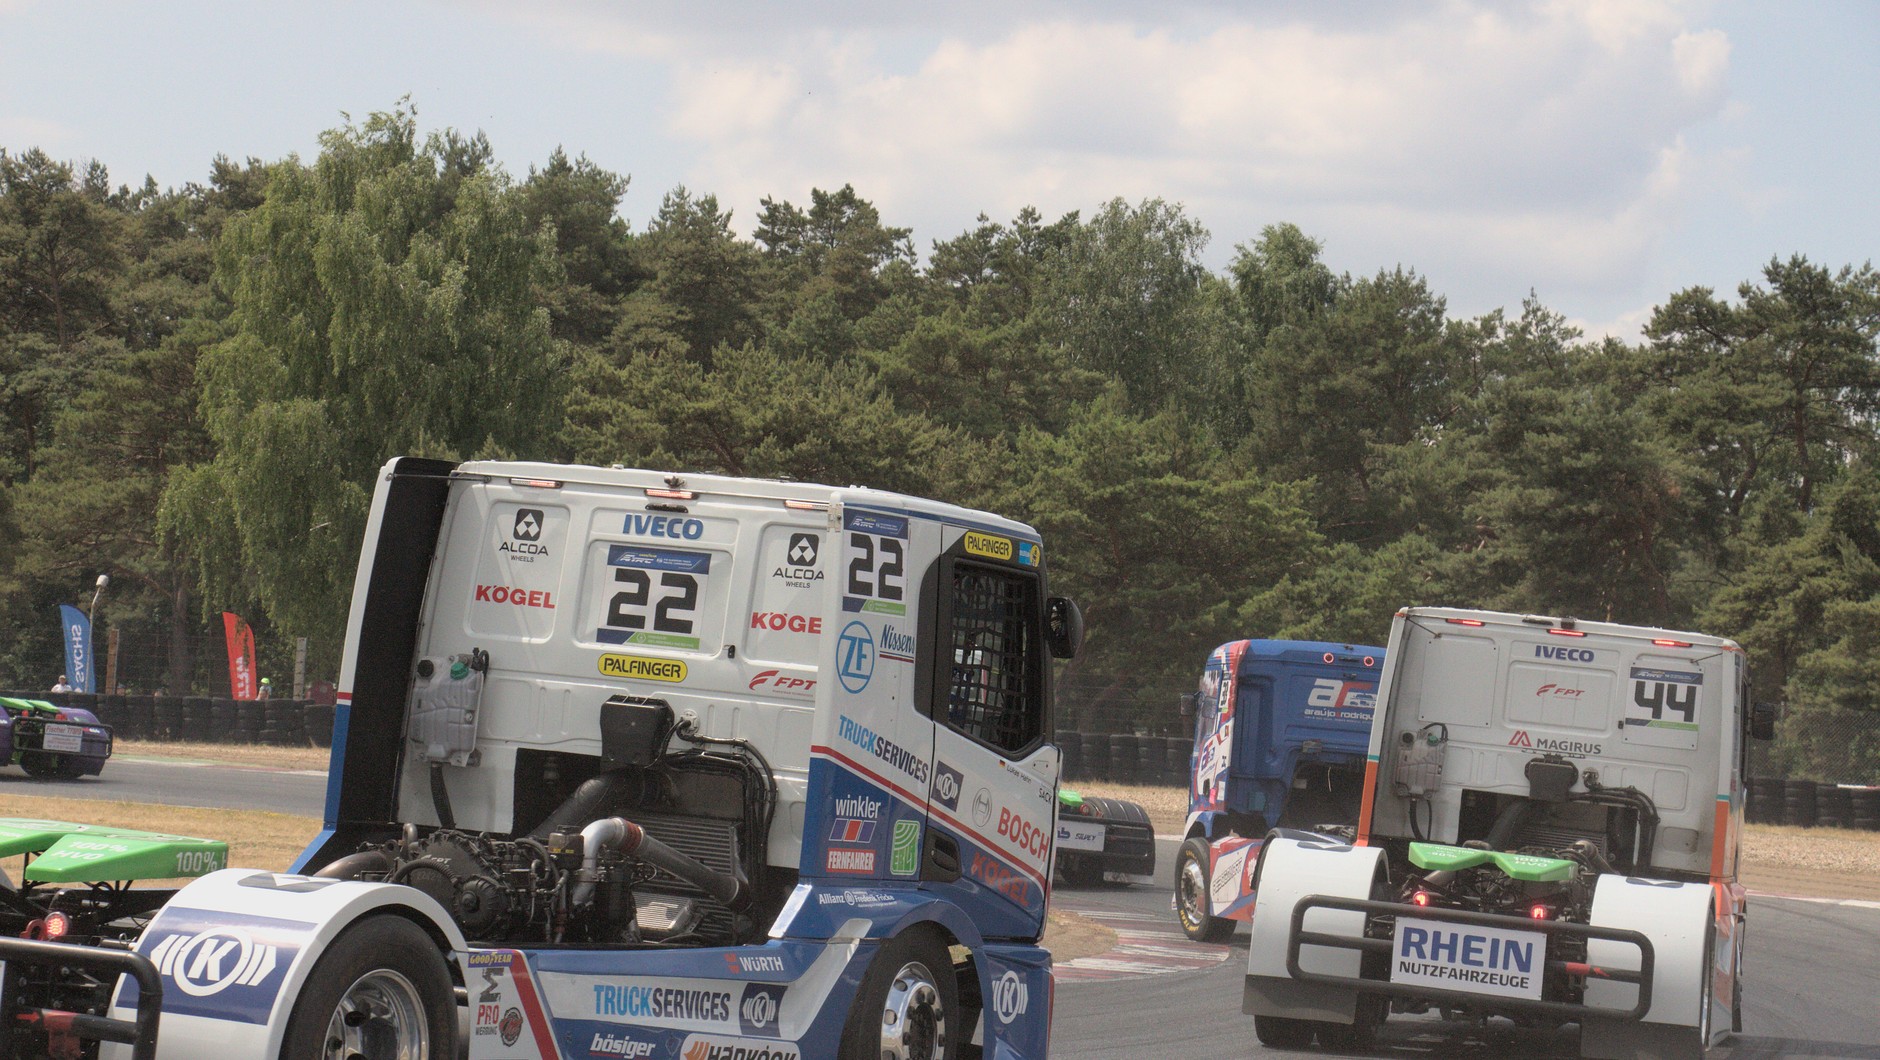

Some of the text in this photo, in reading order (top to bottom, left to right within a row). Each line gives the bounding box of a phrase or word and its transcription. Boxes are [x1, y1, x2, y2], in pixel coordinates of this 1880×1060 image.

[622, 513, 704, 540] IVECO
[499, 541, 549, 556] ALCOA
[967, 535, 1010, 556] PALFINGER
[510, 555, 534, 563] WHEELS
[848, 533, 903, 601] 22
[772, 567, 824, 581] ALCOA
[475, 584, 555, 609] KÖGEL
[607, 568, 698, 634] 22
[880, 623, 915, 654] Nissens
[840, 634, 873, 680] ZF
[1535, 645, 1595, 662] IVECO
[603, 657, 682, 678] PALFINGER
[773, 676, 817, 690] FPT
[1554, 688, 1585, 697] FPT
[1634, 680, 1697, 723] 44
[1536, 738, 1602, 755] MAGIRUS
[835, 794, 882, 819] winkler
[997, 806, 1050, 862] BOSCH
[51, 850, 105, 860] HVO
[71, 841, 128, 853] 100%
[176, 851, 217, 873] 100%
[827, 850, 875, 871] FERNFAHRER
[818, 893, 846, 904] Allianz
[1401, 925, 1533, 973] RHEIN
[739, 956, 785, 971] WÜRTH
[1399, 960, 1530, 989] NUTZFAHRZEUGE
[593, 984, 731, 1022] TRUCKSERVICES
[476, 1004, 500, 1025] PRO
[589, 1033, 656, 1060] bösiger
